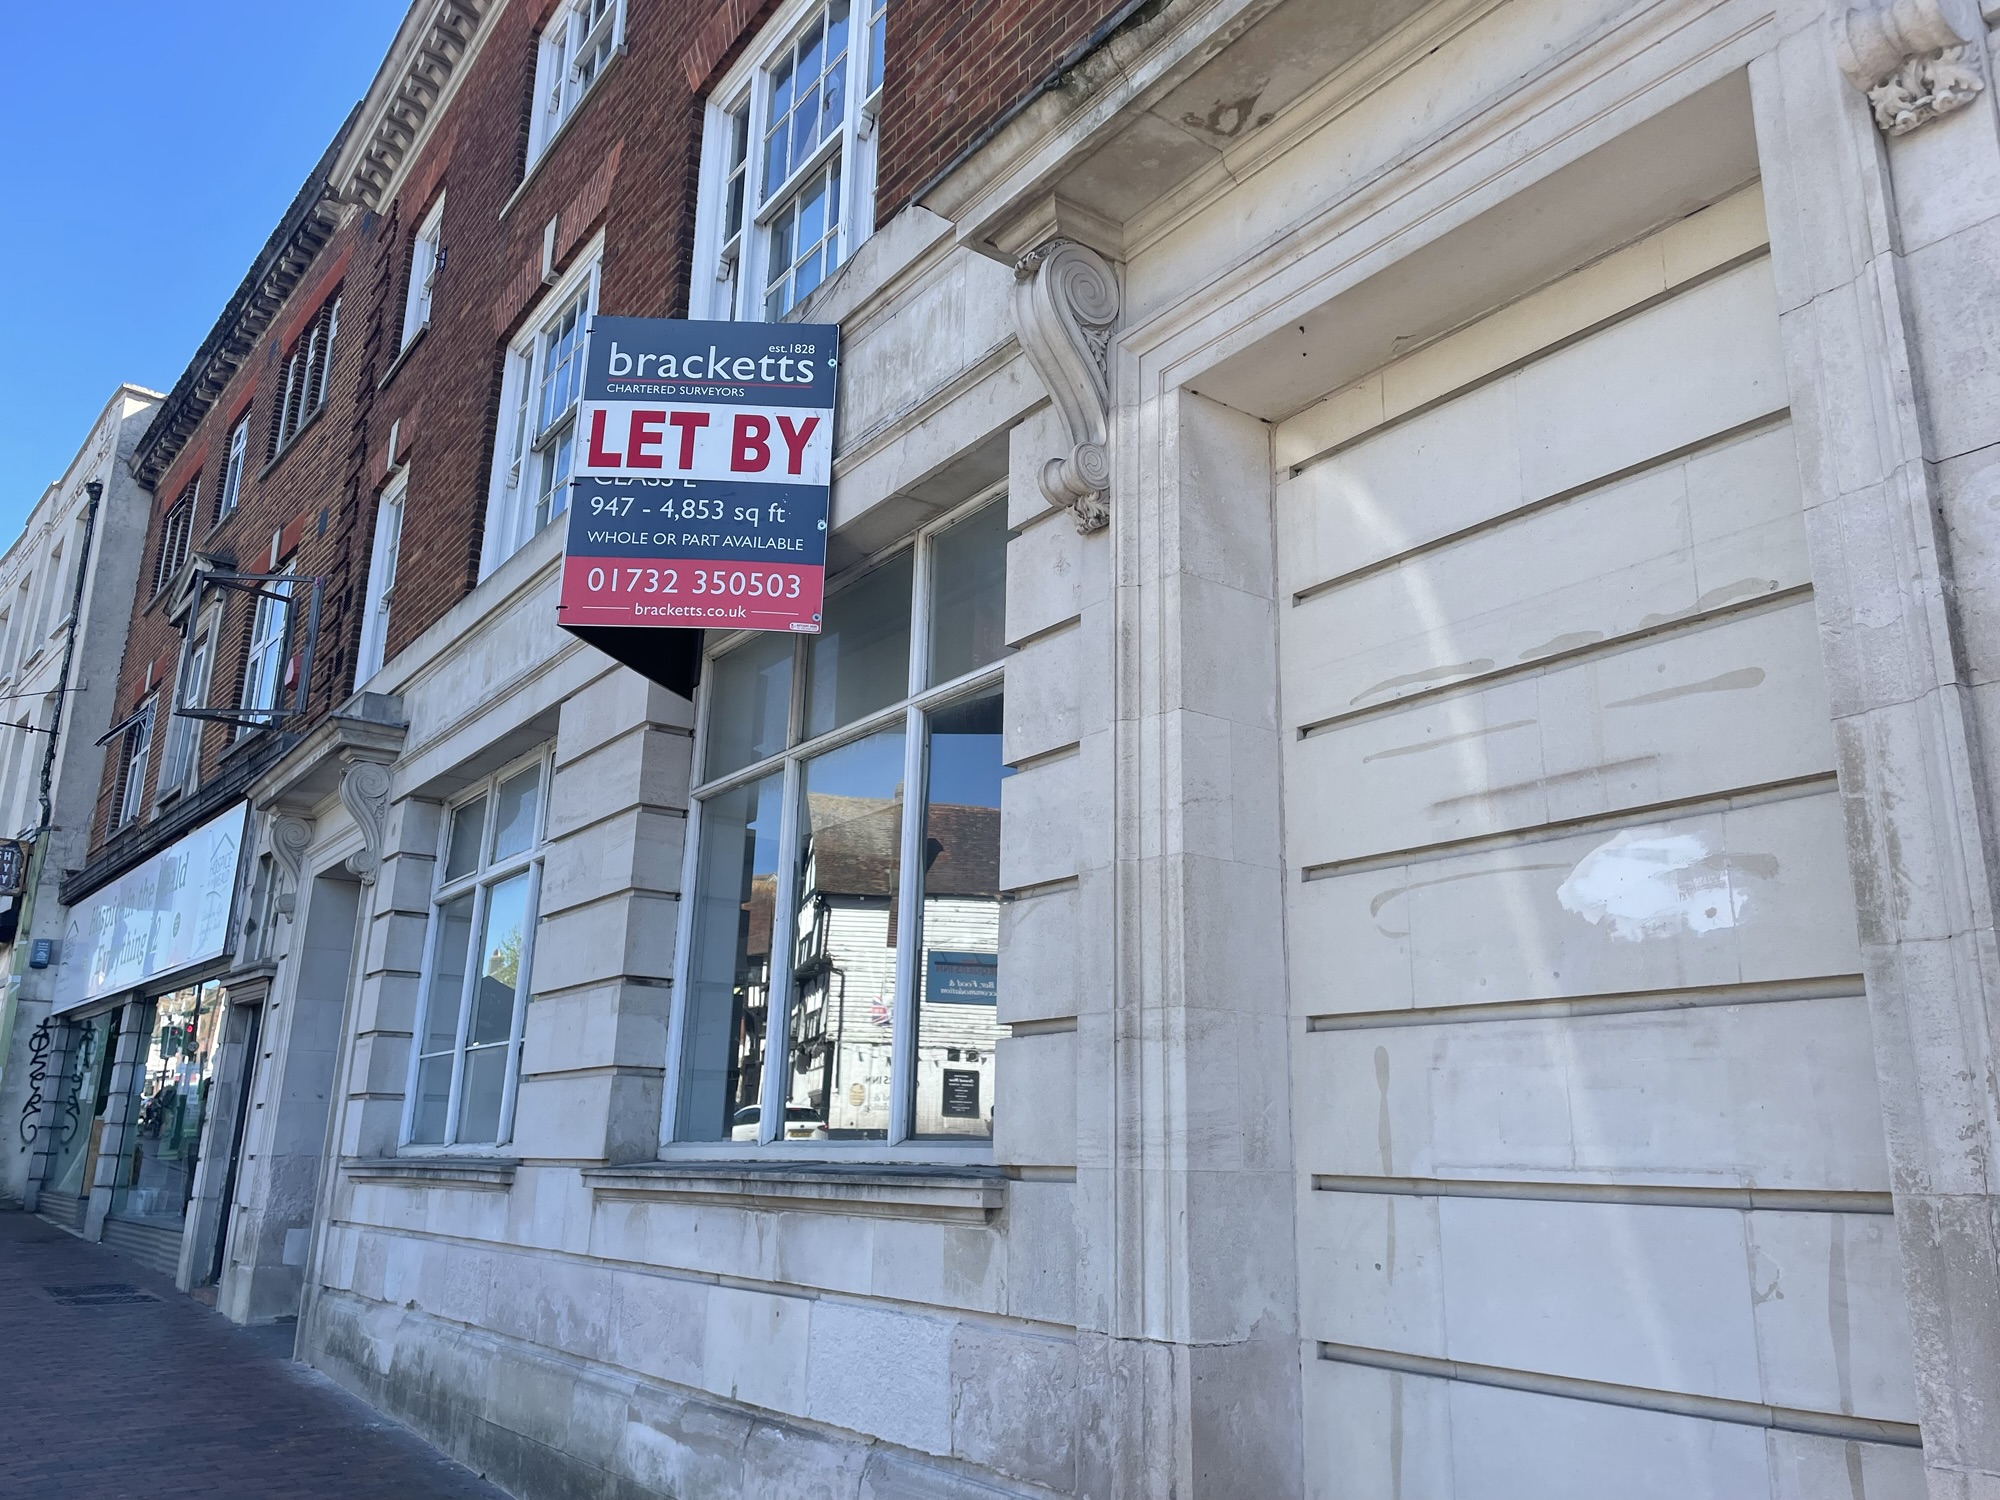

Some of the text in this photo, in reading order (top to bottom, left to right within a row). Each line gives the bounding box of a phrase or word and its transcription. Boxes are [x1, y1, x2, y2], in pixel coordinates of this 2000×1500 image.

[608, 341, 815, 384] bracketts
[606, 383, 745, 397] CHARTERED SURVEYORS
[587, 409, 821, 475] LET BY
[590, 496, 635, 517] 947
[659, 498, 724, 522] 4,853
[733, 506, 759, 528] sq
[768, 502, 786, 523] ft
[587, 530, 804, 551] WHOLE OR PART AVAILABLE
[587, 567, 801, 599] 01732 350503
[634, 602, 747, 618] bracketts.co.uk
